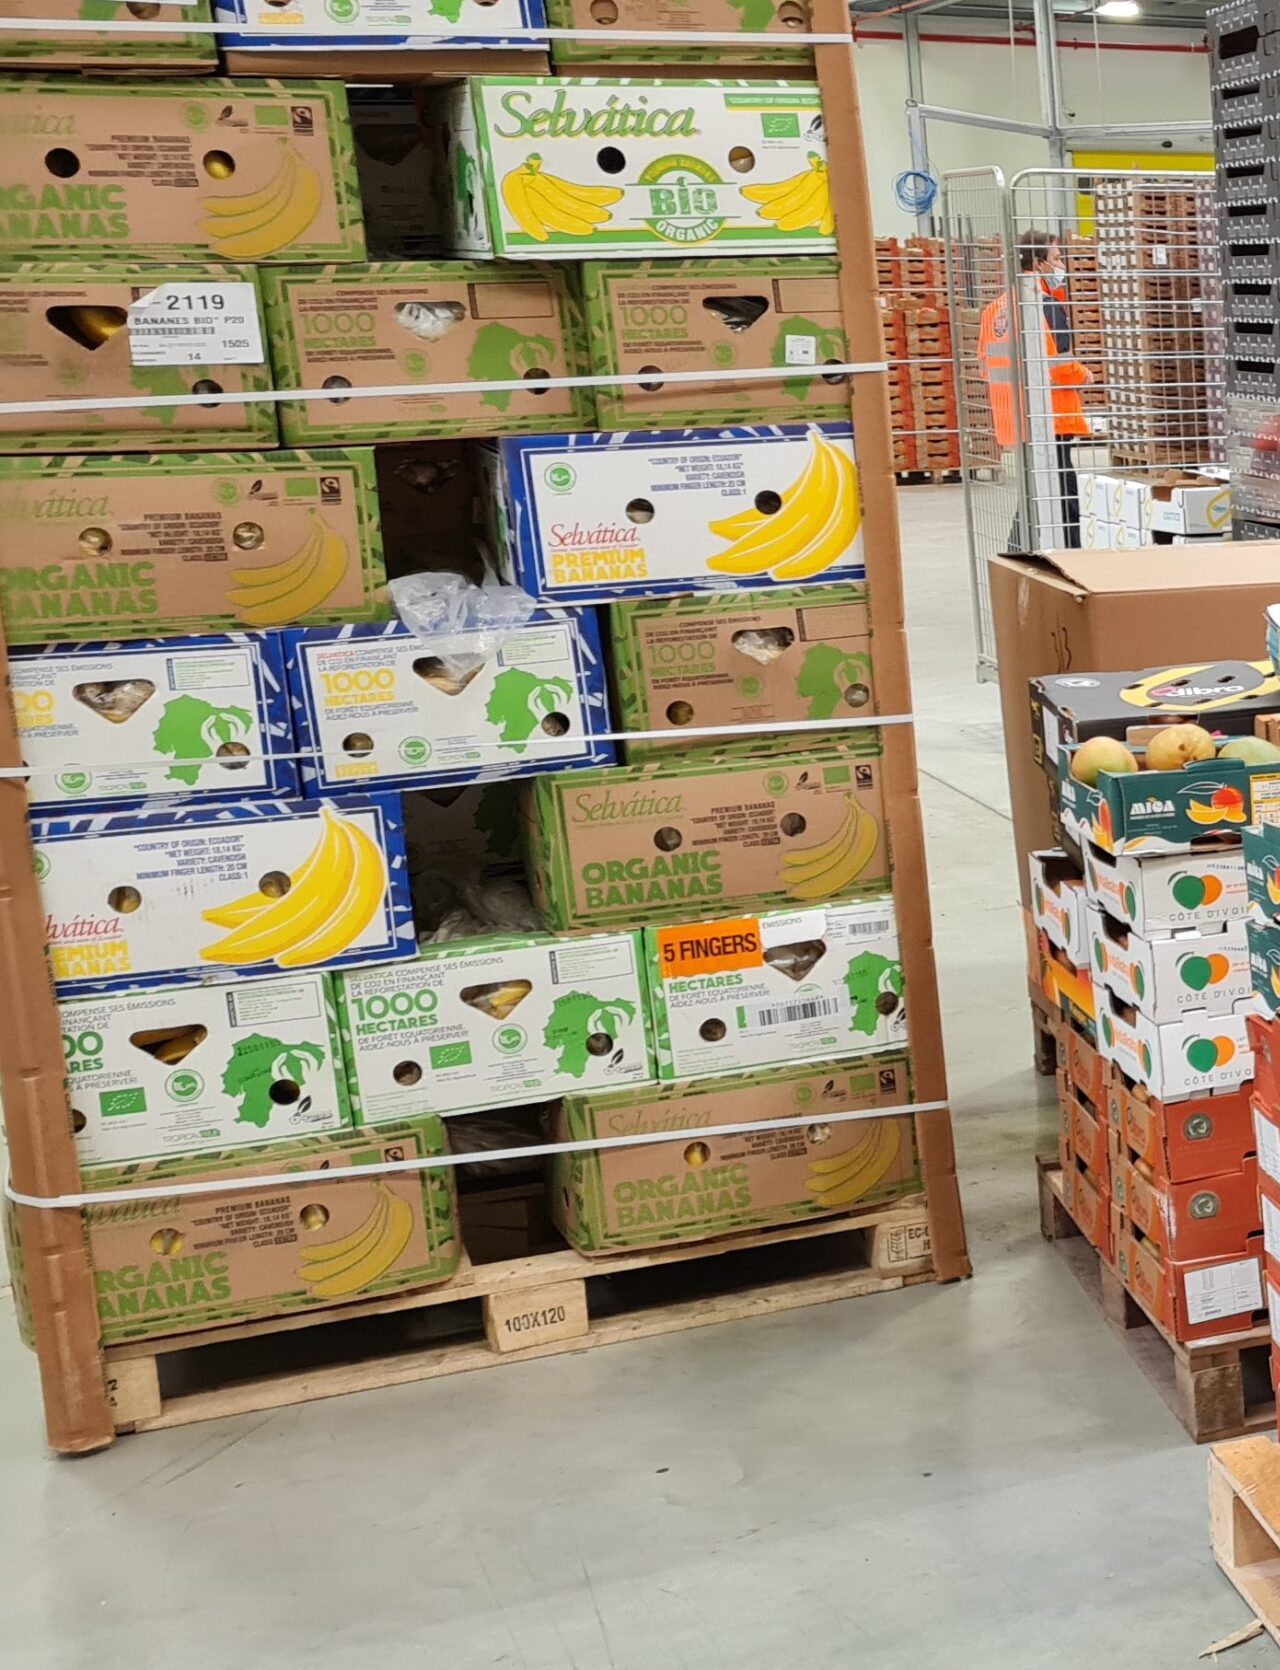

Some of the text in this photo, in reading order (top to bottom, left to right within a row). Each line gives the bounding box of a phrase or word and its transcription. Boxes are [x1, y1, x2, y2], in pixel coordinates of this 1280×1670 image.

[494, 89, 701, 138] Selvática
[0, 184, 127, 211] GANIC
[0, 213, 130, 239] NANAS
[166, 294, 225, 310] 2119
[548, 521, 640, 548] Selvática
[552, 548, 646, 568] PREMIUM
[554, 565, 648, 583] BANANAS
[320, 667, 396, 694] 1000
[572, 790, 684, 824] Selvática
[581, 850, 722, 885] ORGANIC
[584, 873, 724, 909] BANANAS
[44, 914, 124, 941] lvática
[1169, 908, 1202, 922] CÔTE
[52, 941, 129, 963] EMIUM
[664, 932, 758, 962] 5 FINGERS
[53, 958, 133, 980] NANAS
[668, 973, 744, 994] HECTARES
[1177, 986, 1251, 1004] CÔTE D'IVOI
[62, 1006, 106, 1018] OMPENSE
[351, 989, 438, 1021] 1000
[356, 1014, 438, 1036] HECTARES
[1184, 1068, 1251, 1087] CÔTE D'IVO
[613, 1163, 749, 1204] ORGANIC
[616, 1183, 752, 1229] BANANAS
[97, 1252, 231, 1295] RGANIC
[97, 1277, 232, 1318] ANANAS
[503, 1305, 566, 1334] 100X120
